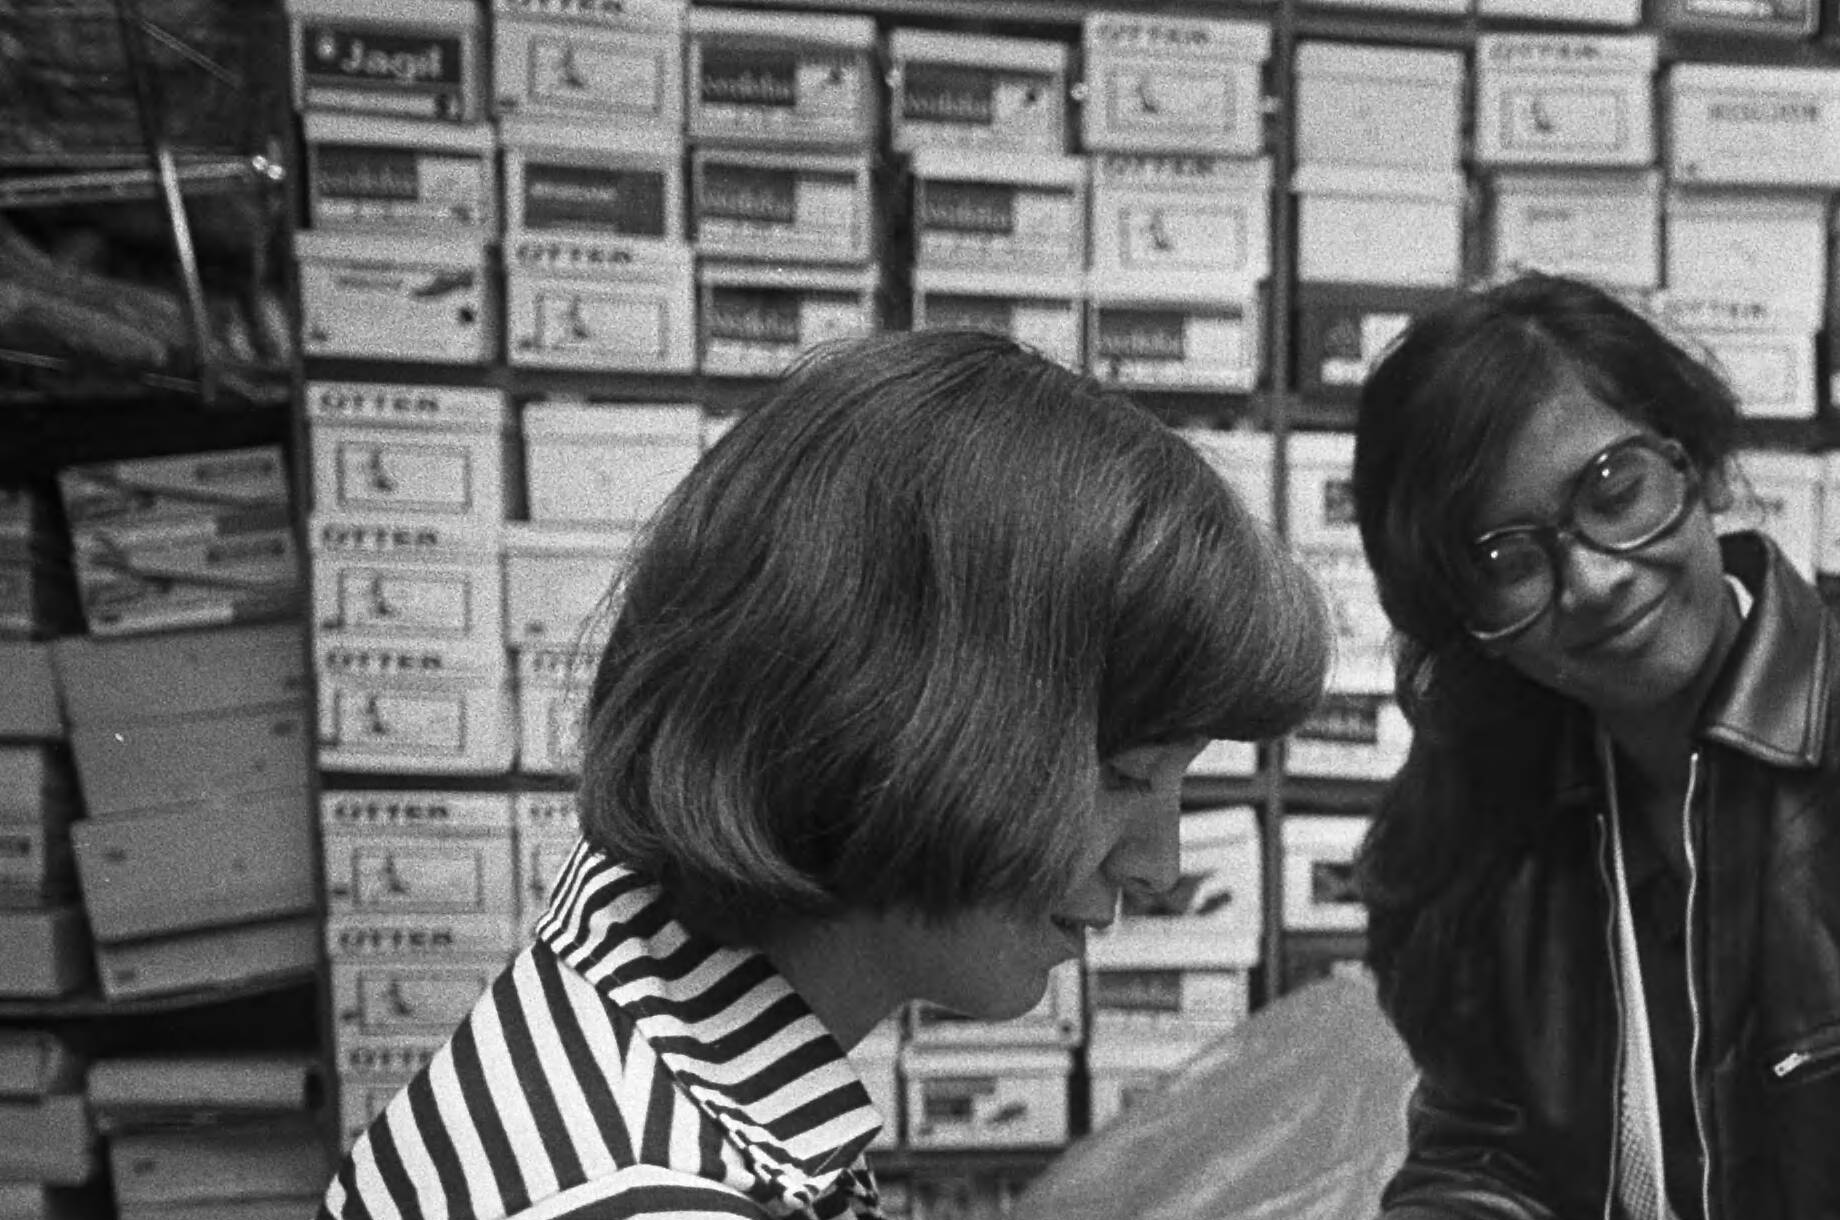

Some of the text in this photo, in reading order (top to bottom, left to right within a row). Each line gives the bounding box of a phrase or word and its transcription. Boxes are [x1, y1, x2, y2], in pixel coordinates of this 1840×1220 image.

[319, 391, 440, 413] OTTER
[321, 523, 438, 547] OTTER
[327, 648, 443, 671] OTTER
[335, 799, 449, 822] OTTER
[340, 926, 454, 949] OTTER
